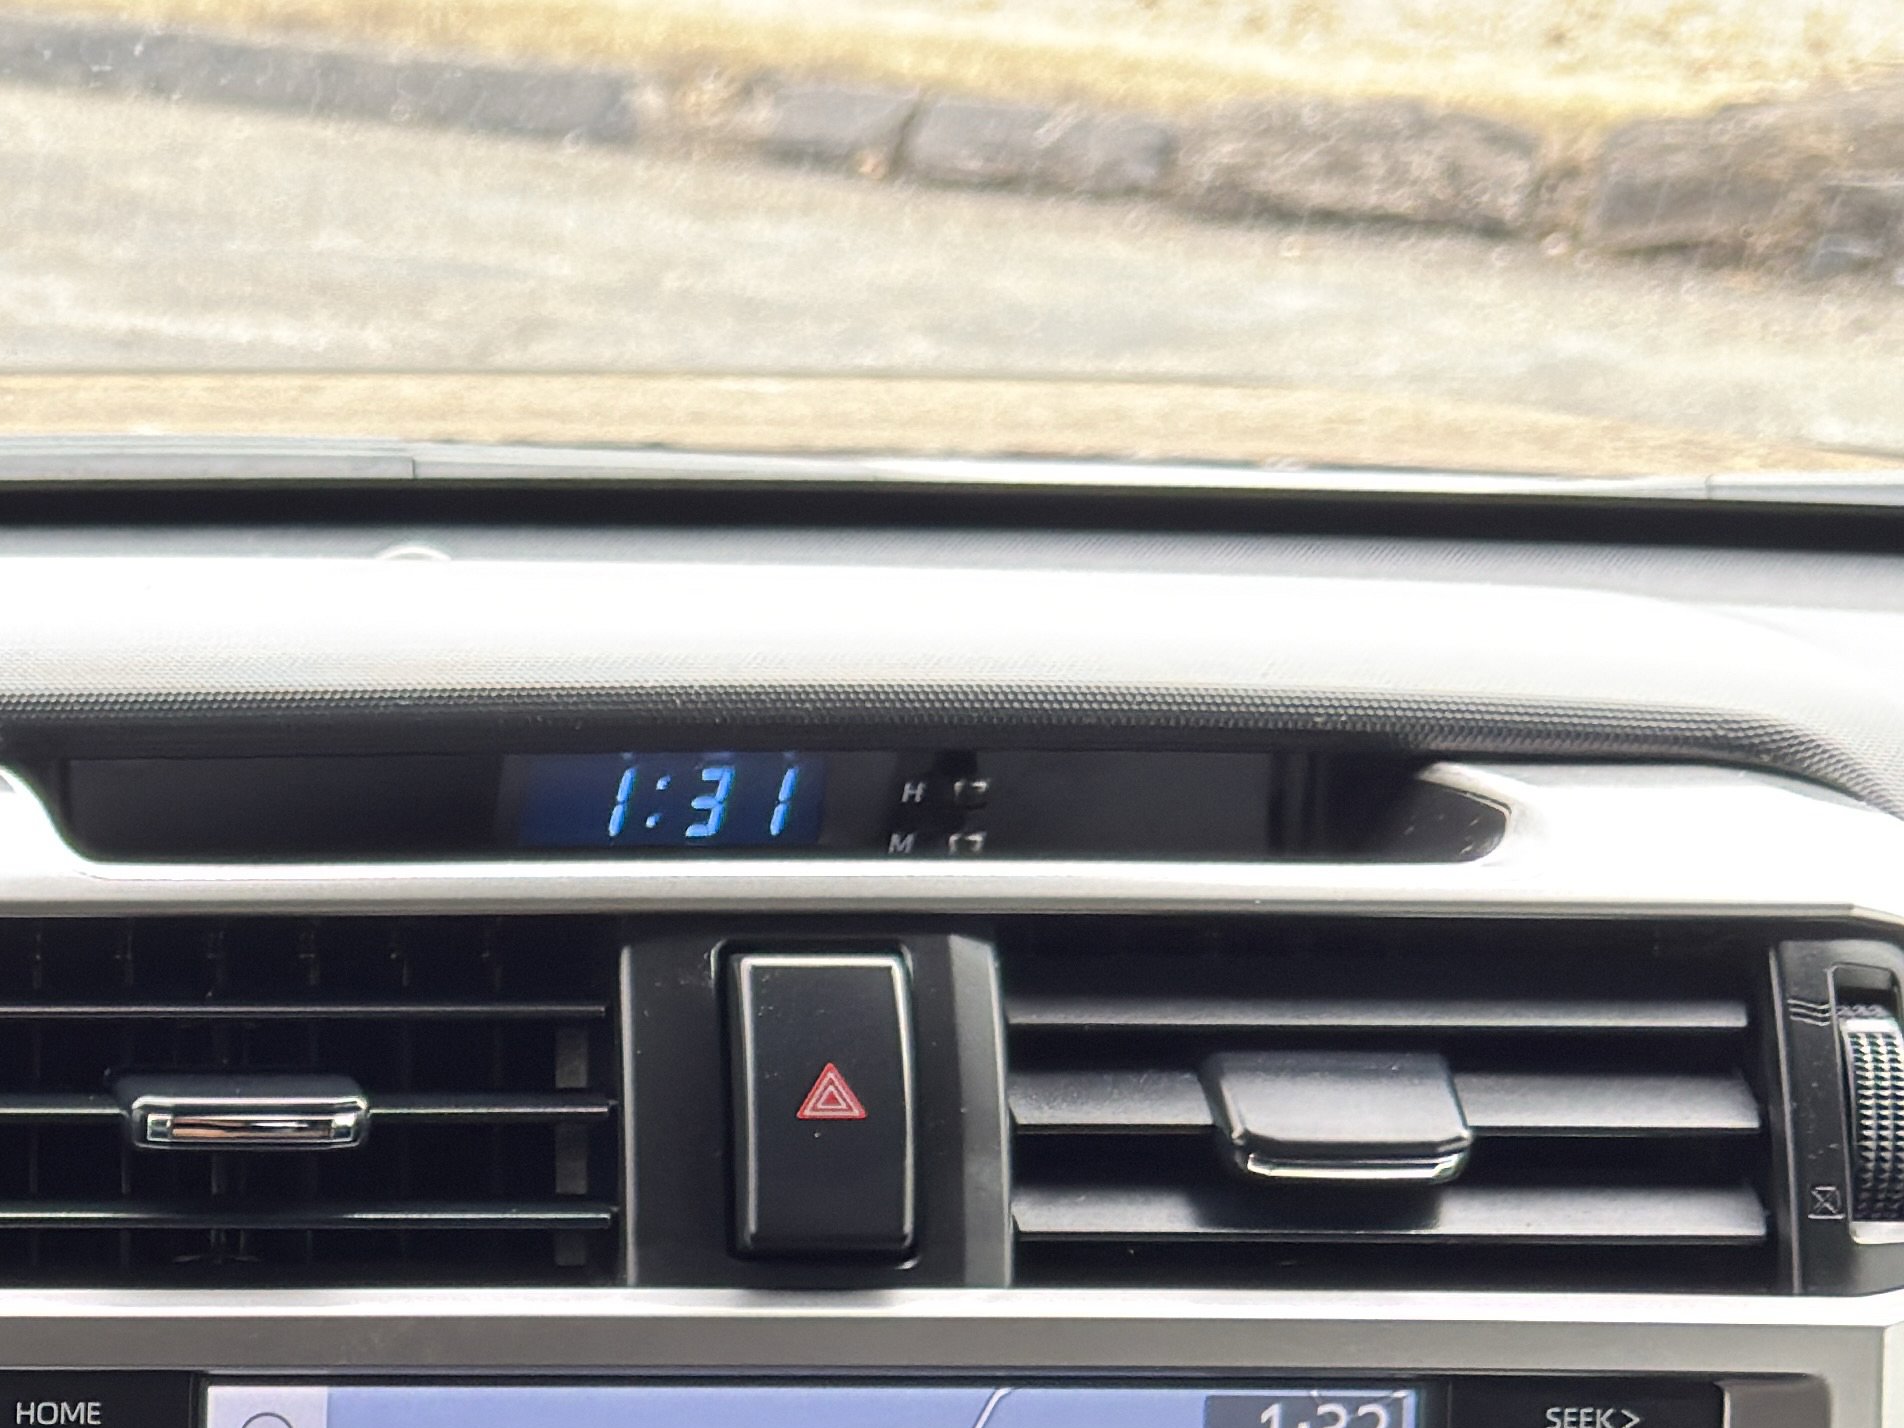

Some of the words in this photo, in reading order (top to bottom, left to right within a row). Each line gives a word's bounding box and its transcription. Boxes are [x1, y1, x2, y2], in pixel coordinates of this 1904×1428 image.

[607, 766, 800, 839] 1:31
[900, 781, 926, 803] H
[887, 832, 915, 854] M
[15, 1401, 103, 1426] HOME
